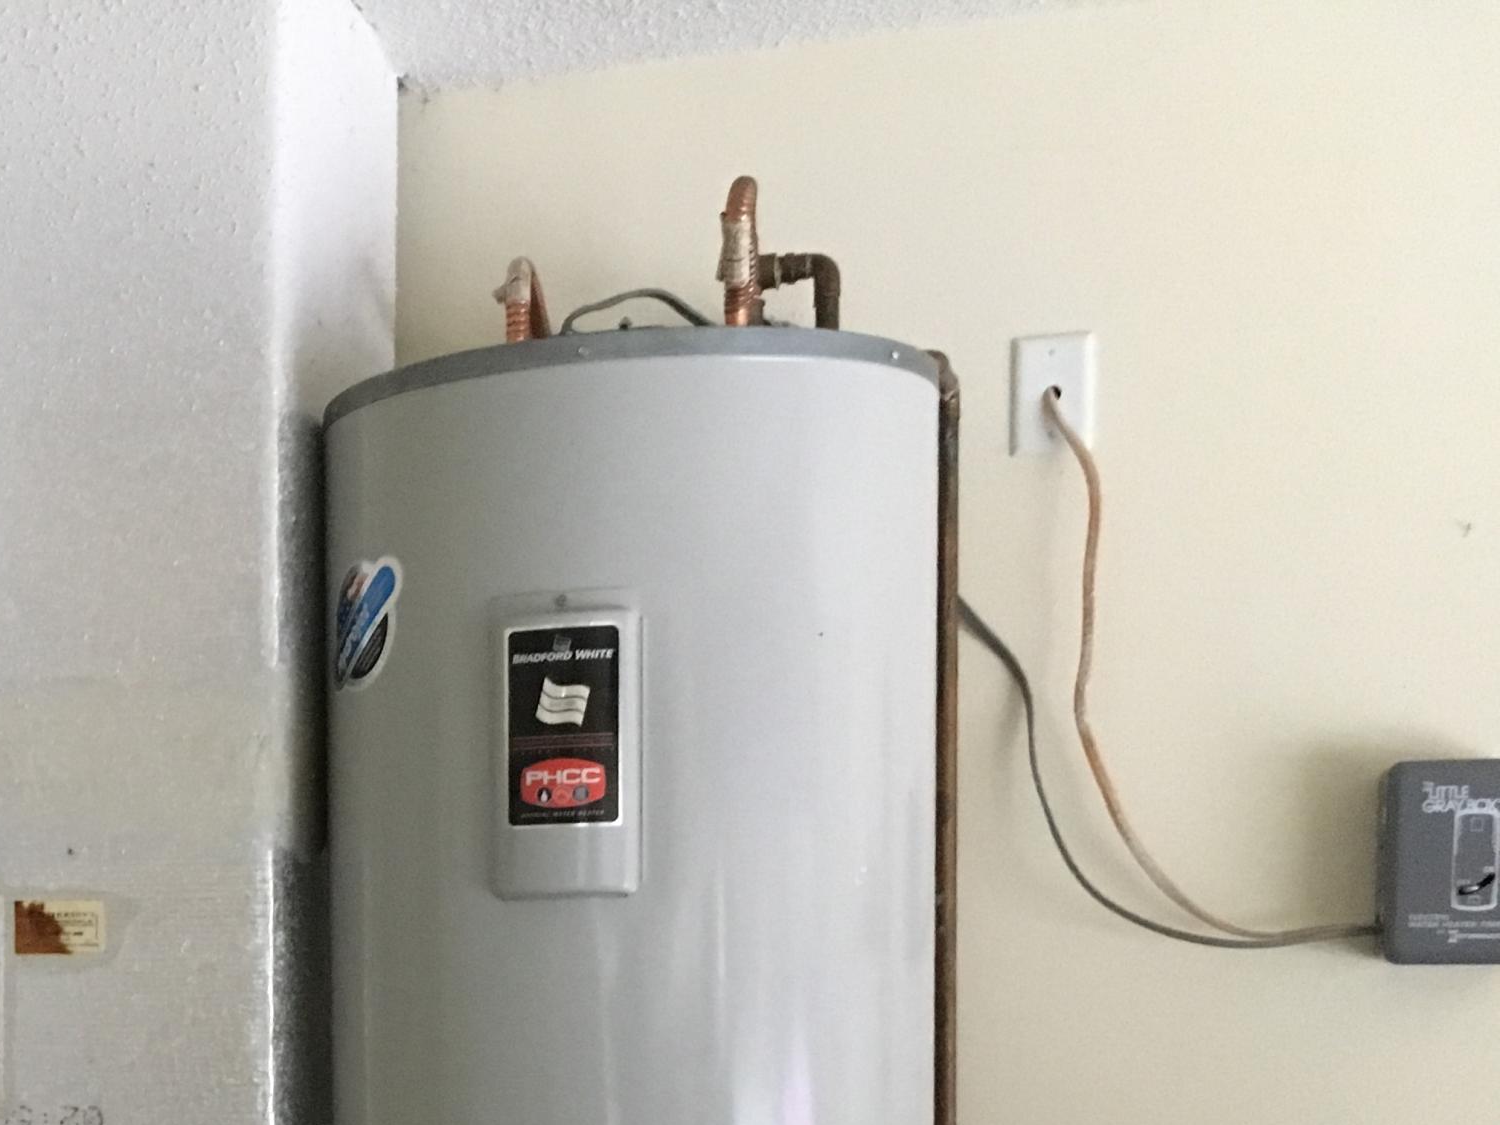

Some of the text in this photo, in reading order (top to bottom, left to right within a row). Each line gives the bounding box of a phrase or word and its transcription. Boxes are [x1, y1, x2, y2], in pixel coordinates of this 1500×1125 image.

[512, 648, 614, 665] BRADFORD WHITE
[525, 768, 601, 786] PHCC
